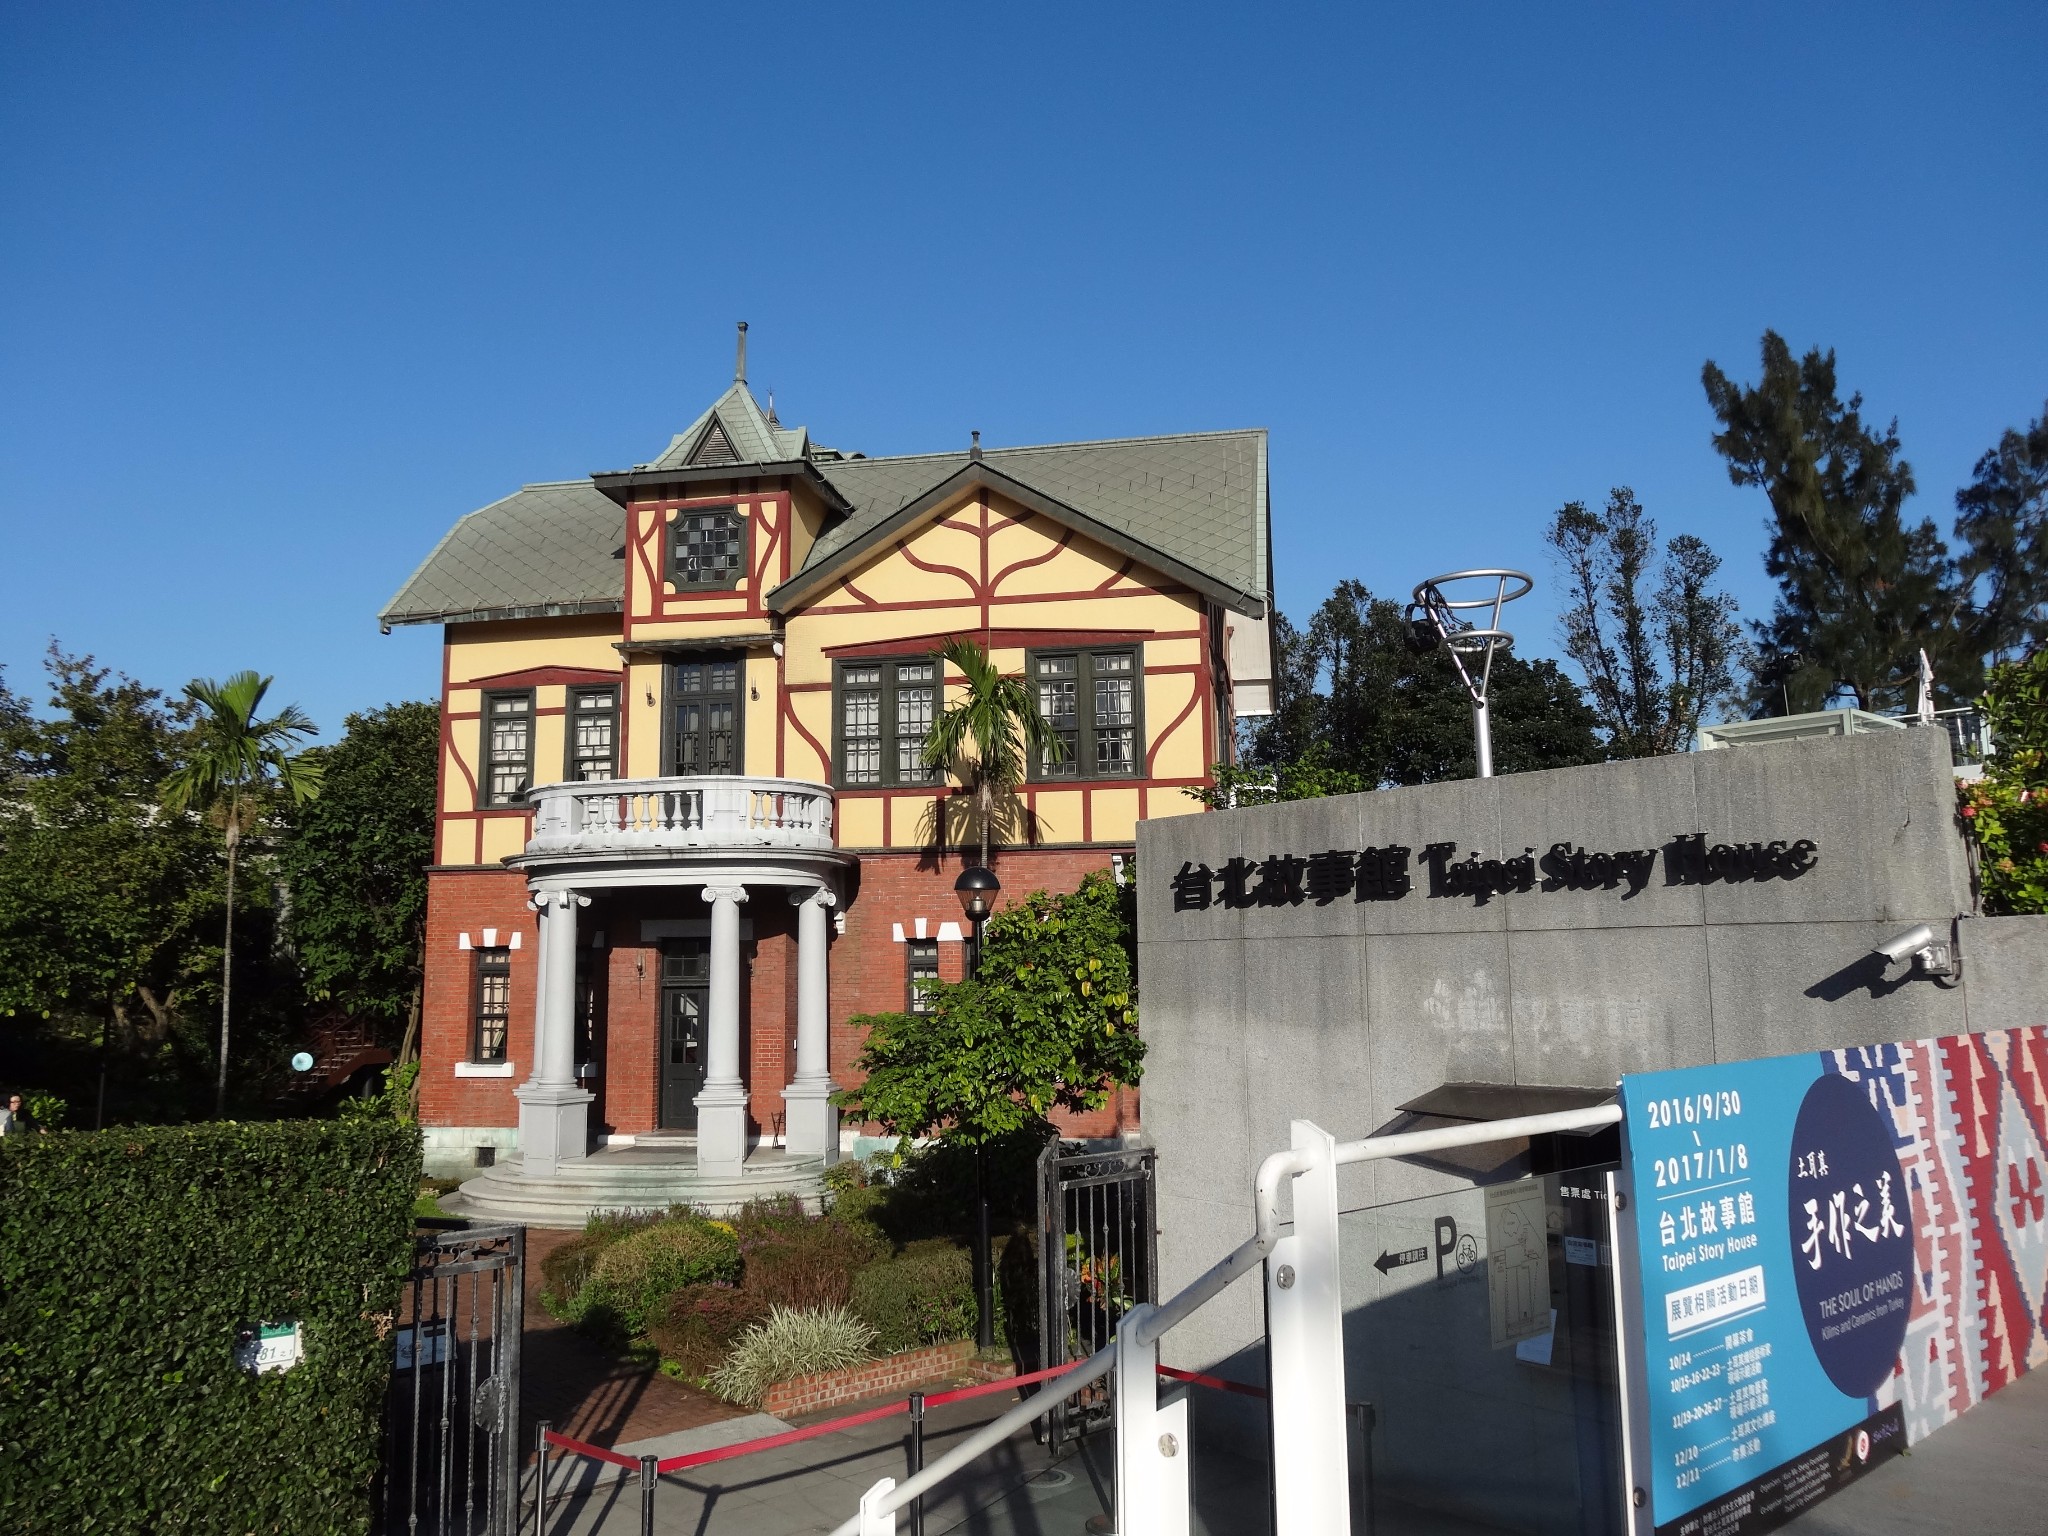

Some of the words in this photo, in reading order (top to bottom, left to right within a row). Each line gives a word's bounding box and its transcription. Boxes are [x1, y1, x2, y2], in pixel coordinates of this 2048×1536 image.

[1171, 844, 1411, 911] 台北故事館
[1420, 842, 1537, 906] Taipei
[1540, 841, 1658, 900] Story
[1663, 832, 1818, 886] House
[1648, 1090, 1740, 1128] 2016/9/30
[1655, 1143, 1748, 1187] 2017/1/8
[1798, 1150, 1829, 1179] 土耳其
[1560, 1186, 1592, 1200] 售票處
[1660, 1191, 1755, 1247] 台北故事館
[1801, 1170, 1905, 1271] 手作之美
[1435, 1215, 1457, 1280] P
[1662, 1247, 1697, 1272] Taipei
[1699, 1243, 1725, 1260] Story
[1727, 1233, 1758, 1254] House
[1671, 1275, 1759, 1322] 展覽相關活動日期
[1819, 1297, 1838, 1319] THE
[1839, 1288, 1863, 1313] SOUL
[1862, 1281, 1875, 1302] OF
[1875, 1270, 1904, 1297] HANDS
[1840, 1318, 1852, 1334] and
[1851, 1308, 1876, 1329] Ceramics
[1669, 1351, 1691, 1371] 10/14
[1675, 1445, 1699, 1467] 12/10
[1676, 1467, 1700, 1489] 12/11
